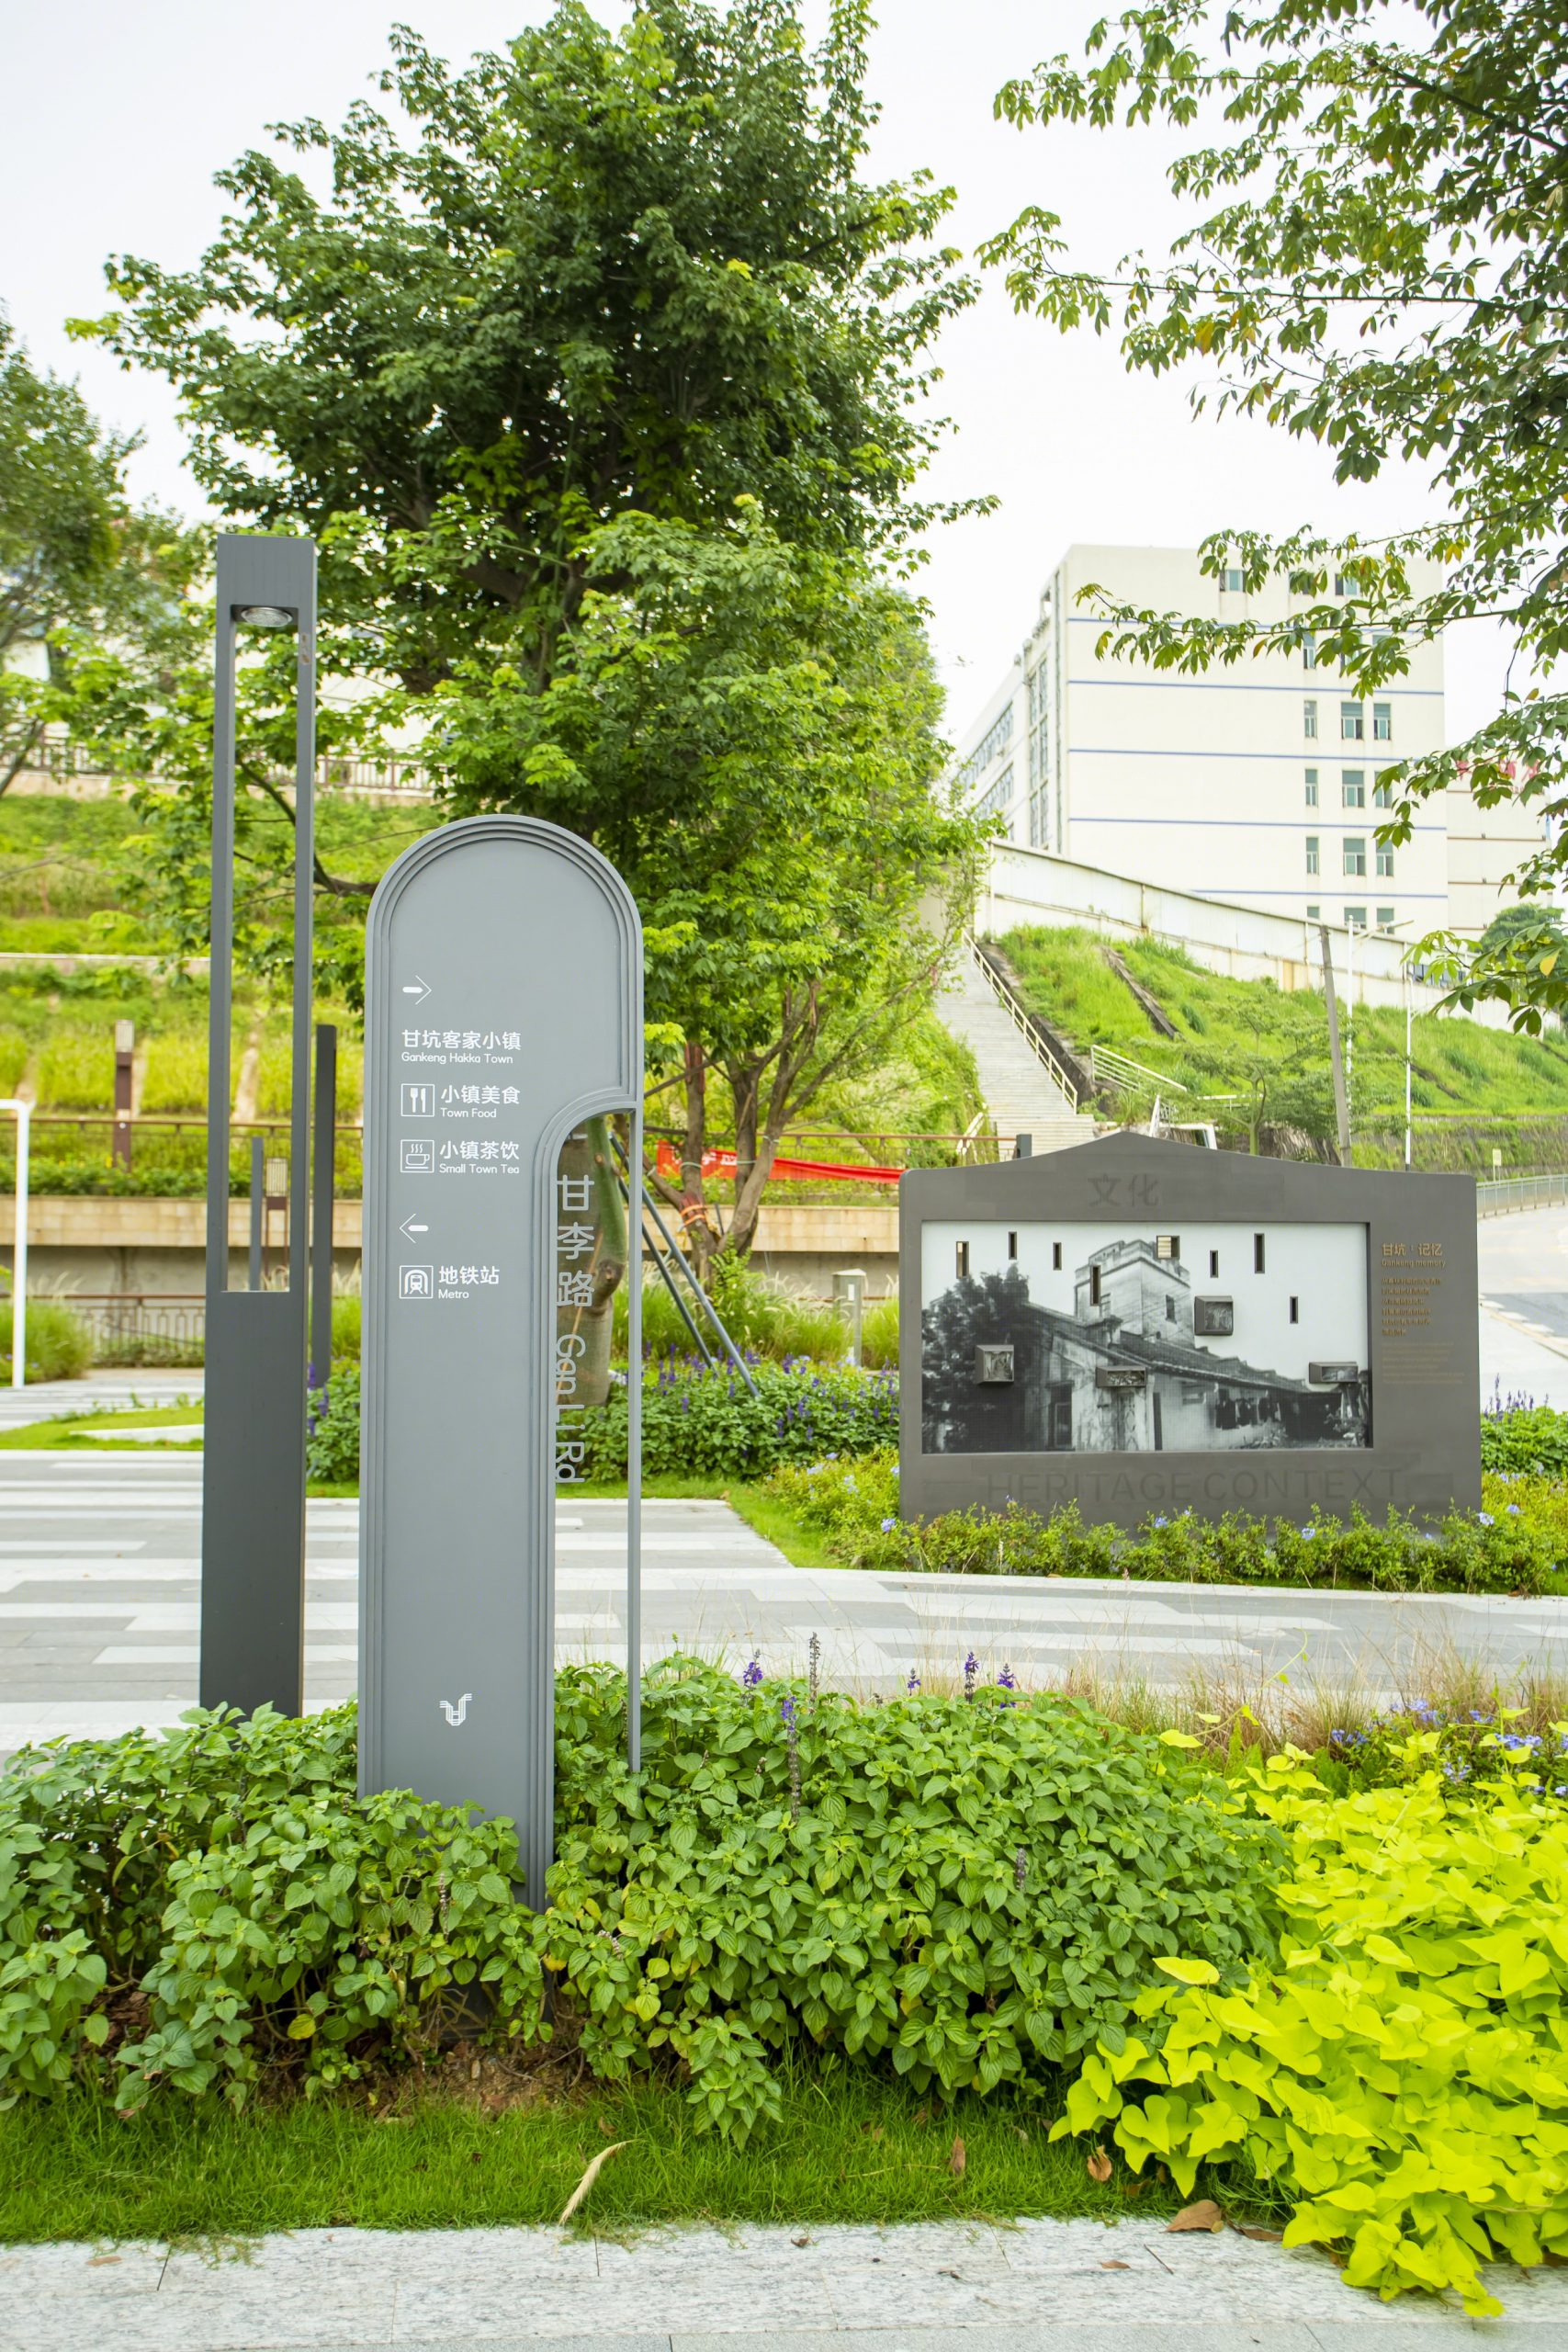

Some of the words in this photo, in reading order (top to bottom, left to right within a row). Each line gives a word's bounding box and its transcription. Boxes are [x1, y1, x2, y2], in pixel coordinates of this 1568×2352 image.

[401, 1029, 522, 1050] 甘坑客家小镇
[401, 1051, 446, 1064] Gankeng
[449, 1052, 481, 1063] Hakka
[483, 1053, 513, 1064] Town
[441, 1084, 521, 1104] 小镇美食
[440, 1107, 468, 1118] Town
[471, 1107, 497, 1118] Food
[439, 1140, 520, 1160] 小镇茶饮
[439, 1163, 466, 1173] Small
[468, 1163, 498, 1174] Town
[501, 1164, 520, 1174] Tea
[1088, 1172, 1160, 1207] 文化
[556, 1174, 595, 1307] 甘李路
[438, 1265, 500, 1285] 地铁站
[438, 1289, 469, 1299] Metro
[556, 1334, 586, 1395] Gan
[556, 1404, 585, 1430] Li
[555, 1442, 585, 1484] Rd
[987, 1470, 1193, 1504] HERITAGE
[1202, 1468, 1404, 1504] CONTEXT
